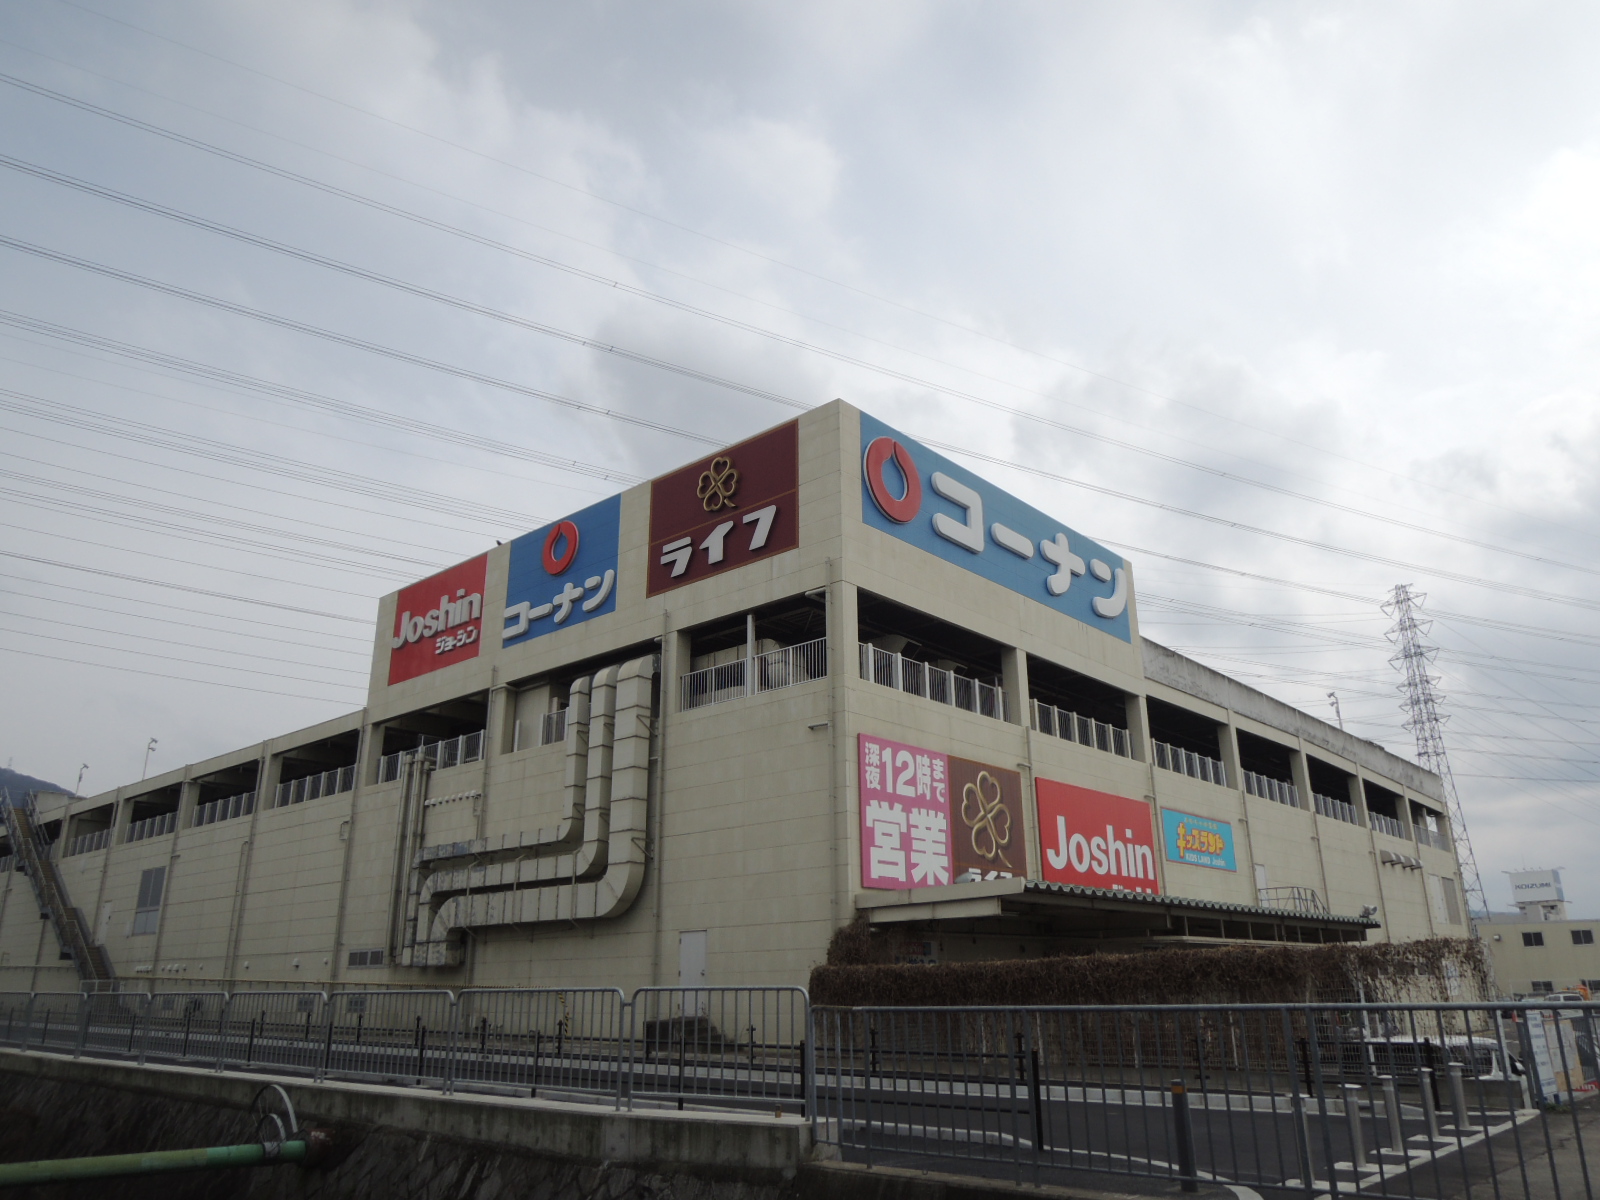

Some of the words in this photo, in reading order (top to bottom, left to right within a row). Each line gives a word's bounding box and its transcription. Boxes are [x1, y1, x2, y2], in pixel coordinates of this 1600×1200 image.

[660, 504, 777, 578] ライフ
[930, 471, 1127, 619] コーナン
[391, 588, 482, 649] Joshin
[502, 568, 616, 640] コーナン
[435, 626, 479, 654] ジョーシン
[866, 800, 949, 885] 営業
[1046, 815, 1155, 880] Joshin
[1514, 882, 1552, 890] KOIZUMI
